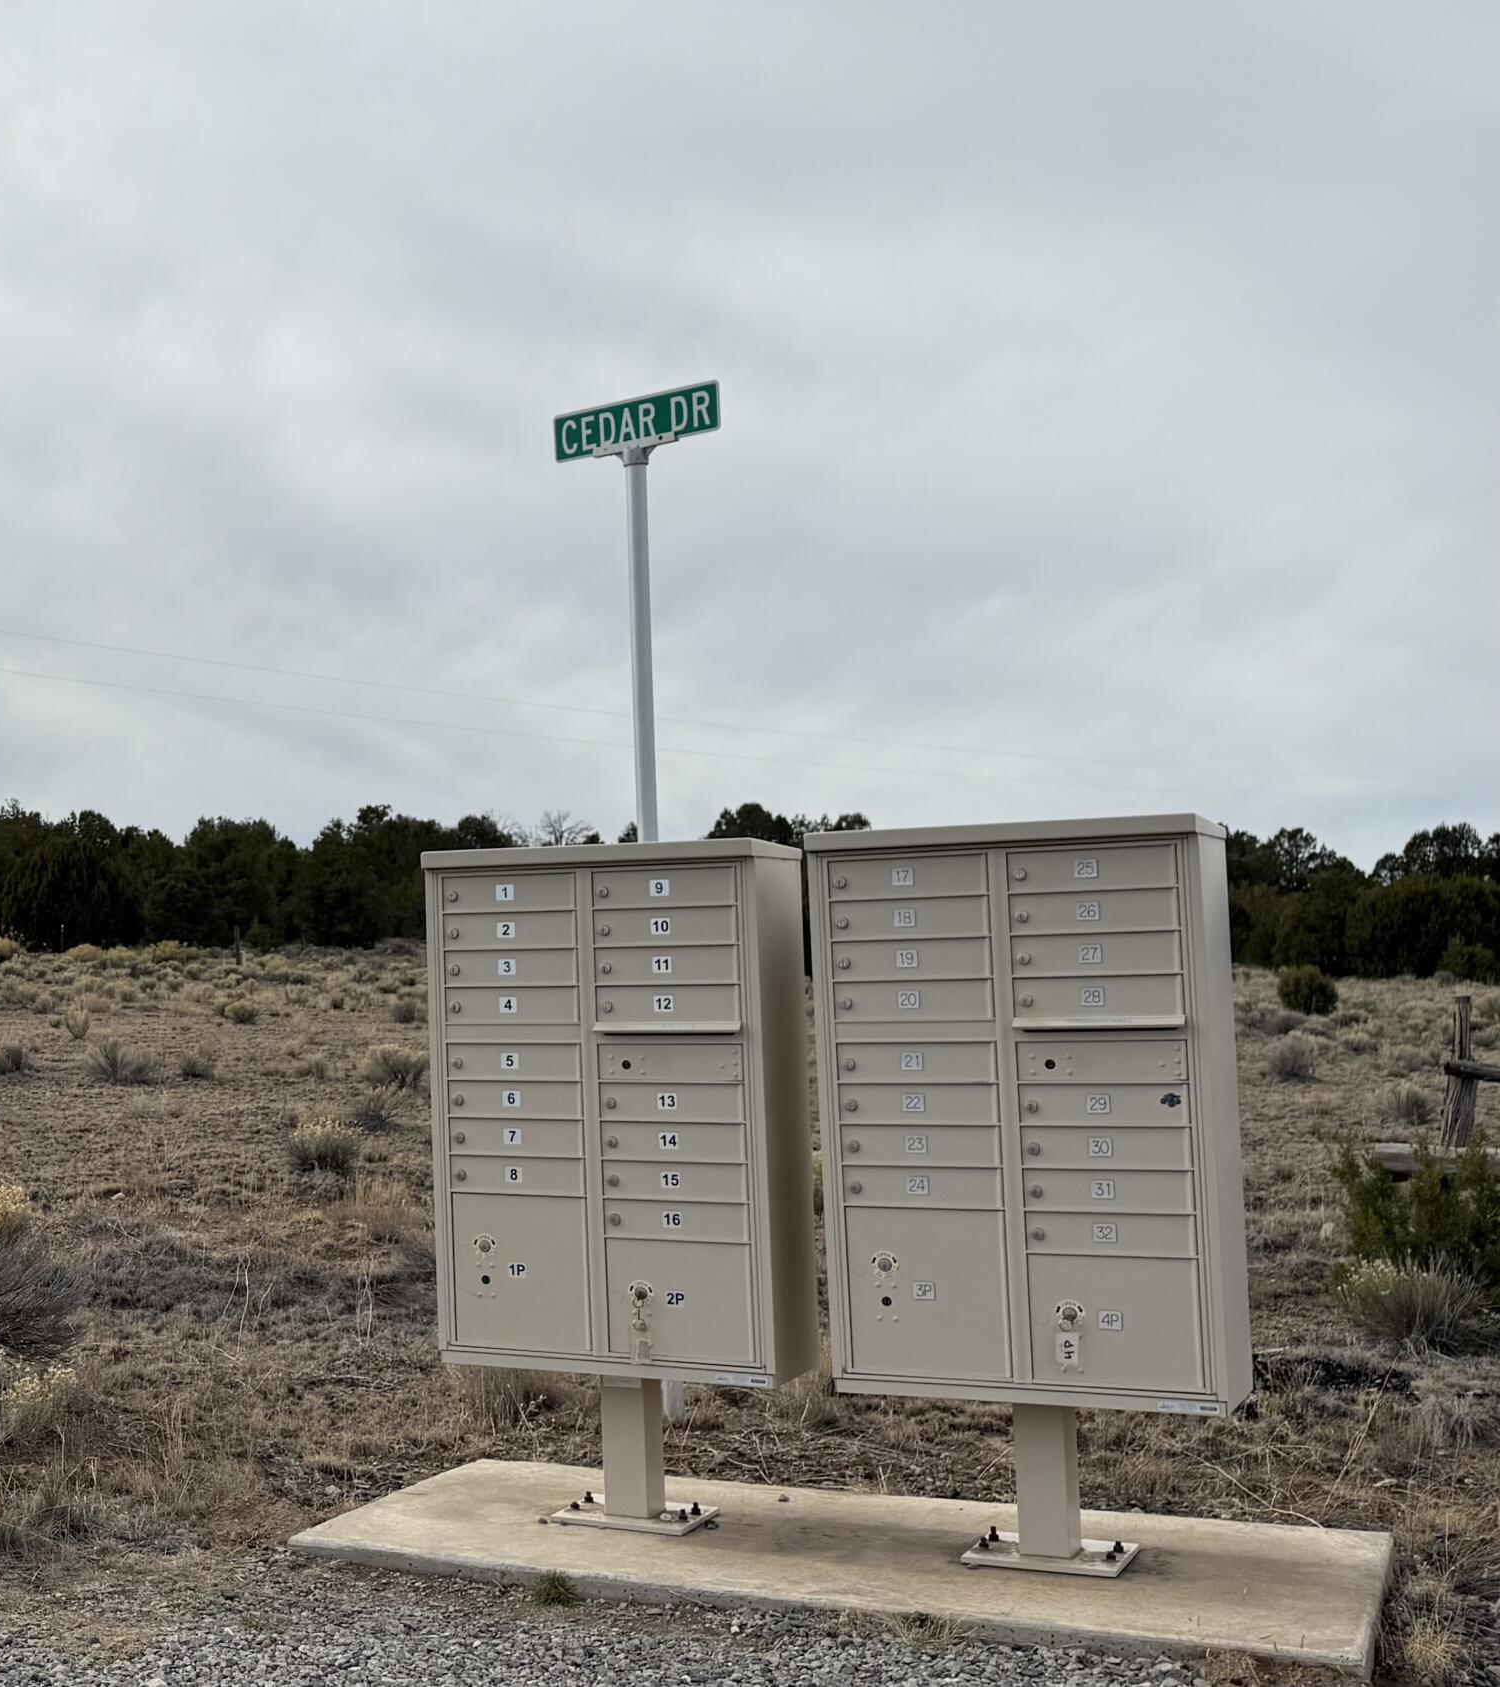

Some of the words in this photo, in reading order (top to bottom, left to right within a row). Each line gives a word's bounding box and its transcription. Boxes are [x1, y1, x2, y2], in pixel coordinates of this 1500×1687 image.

[561, 402, 657, 455] CEDAR
[669, 390, 712, 432] DR
[1077, 861, 1094, 875] 25
[896, 869, 909, 882] 17
[502, 886, 508, 898] 1
[655, 882, 663, 894] 9
[898, 911, 911, 924] 18
[1079, 904, 1096, 918] 26
[502, 924, 510, 936] 2
[653, 920, 669, 932] 10
[900, 951, 914, 965] 19
[1081, 947, 1098, 960] 27
[503, 961, 511, 973] 3
[655, 958, 669, 971] 11
[900, 992, 917, 1006] 20
[1084, 989, 1101, 1003] 28
[504, 999, 512, 1010] 4
[656, 997, 671, 1010] 12
[506, 1055, 514, 1067] 5
[904, 1054, 920, 1068] 21
[507, 1092, 515, 1104] 6
[659, 1095, 675, 1107] 13
[905, 1096, 921, 1110] 22
[1090, 1097, 1107, 1111] 29
[509, 1130, 516, 1142] 7
[660, 1134, 677, 1147] 14
[908, 1137, 924, 1151] 23
[1092, 1140, 1109, 1154] 30
[510, 1168, 518, 1180] 8
[662, 1174, 679, 1186] 15
[909, 1178, 925, 1192] 24
[1095, 1183, 1111, 1197] 31
[664, 1213, 680, 1226] 16
[1097, 1226, 1114, 1240] 32
[509, 1263, 526, 1276] 1P
[916, 1284, 932, 1297] 3P
[666, 1292, 685, 1305] 2P
[1101, 1313, 1119, 1327] 4P
[1063, 1339, 1075, 1359] 4P
